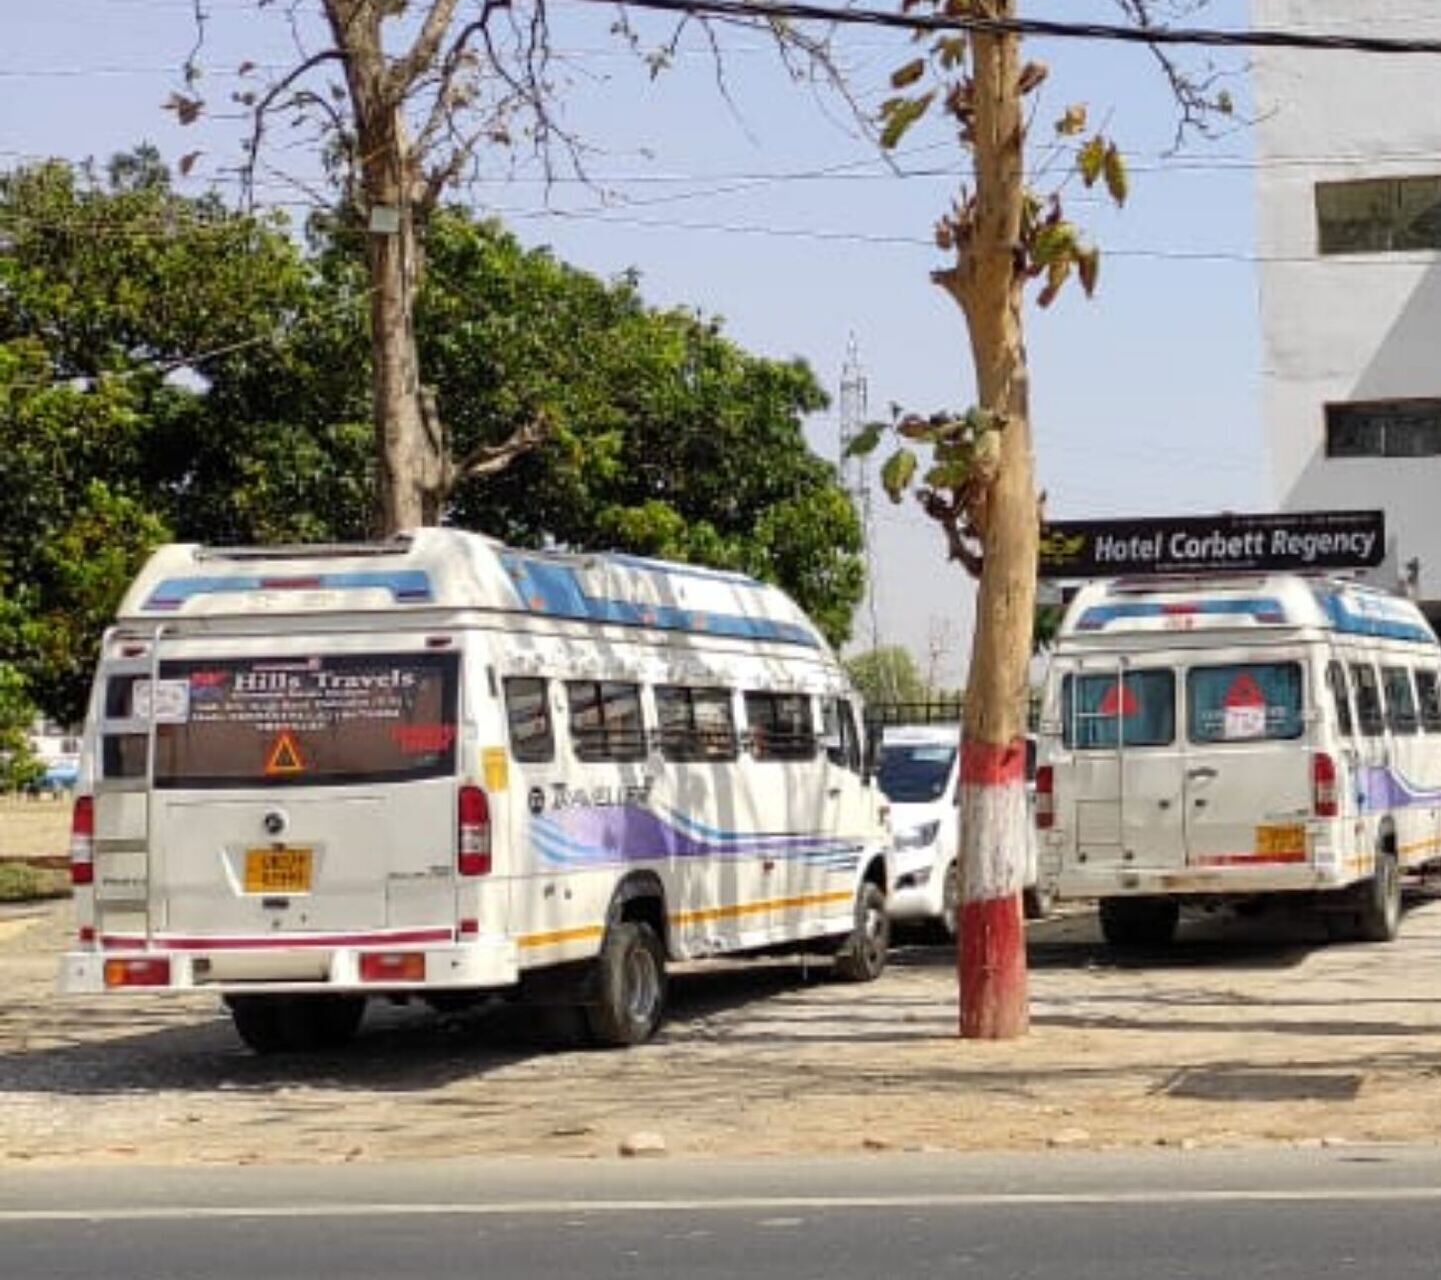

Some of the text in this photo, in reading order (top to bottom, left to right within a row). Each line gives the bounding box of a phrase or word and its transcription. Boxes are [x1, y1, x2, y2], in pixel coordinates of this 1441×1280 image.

[1095, 529, 1377, 562] Hotel Corbett Regency
[235, 671, 301, 691] Hills
[312, 669, 416, 688] Travels
